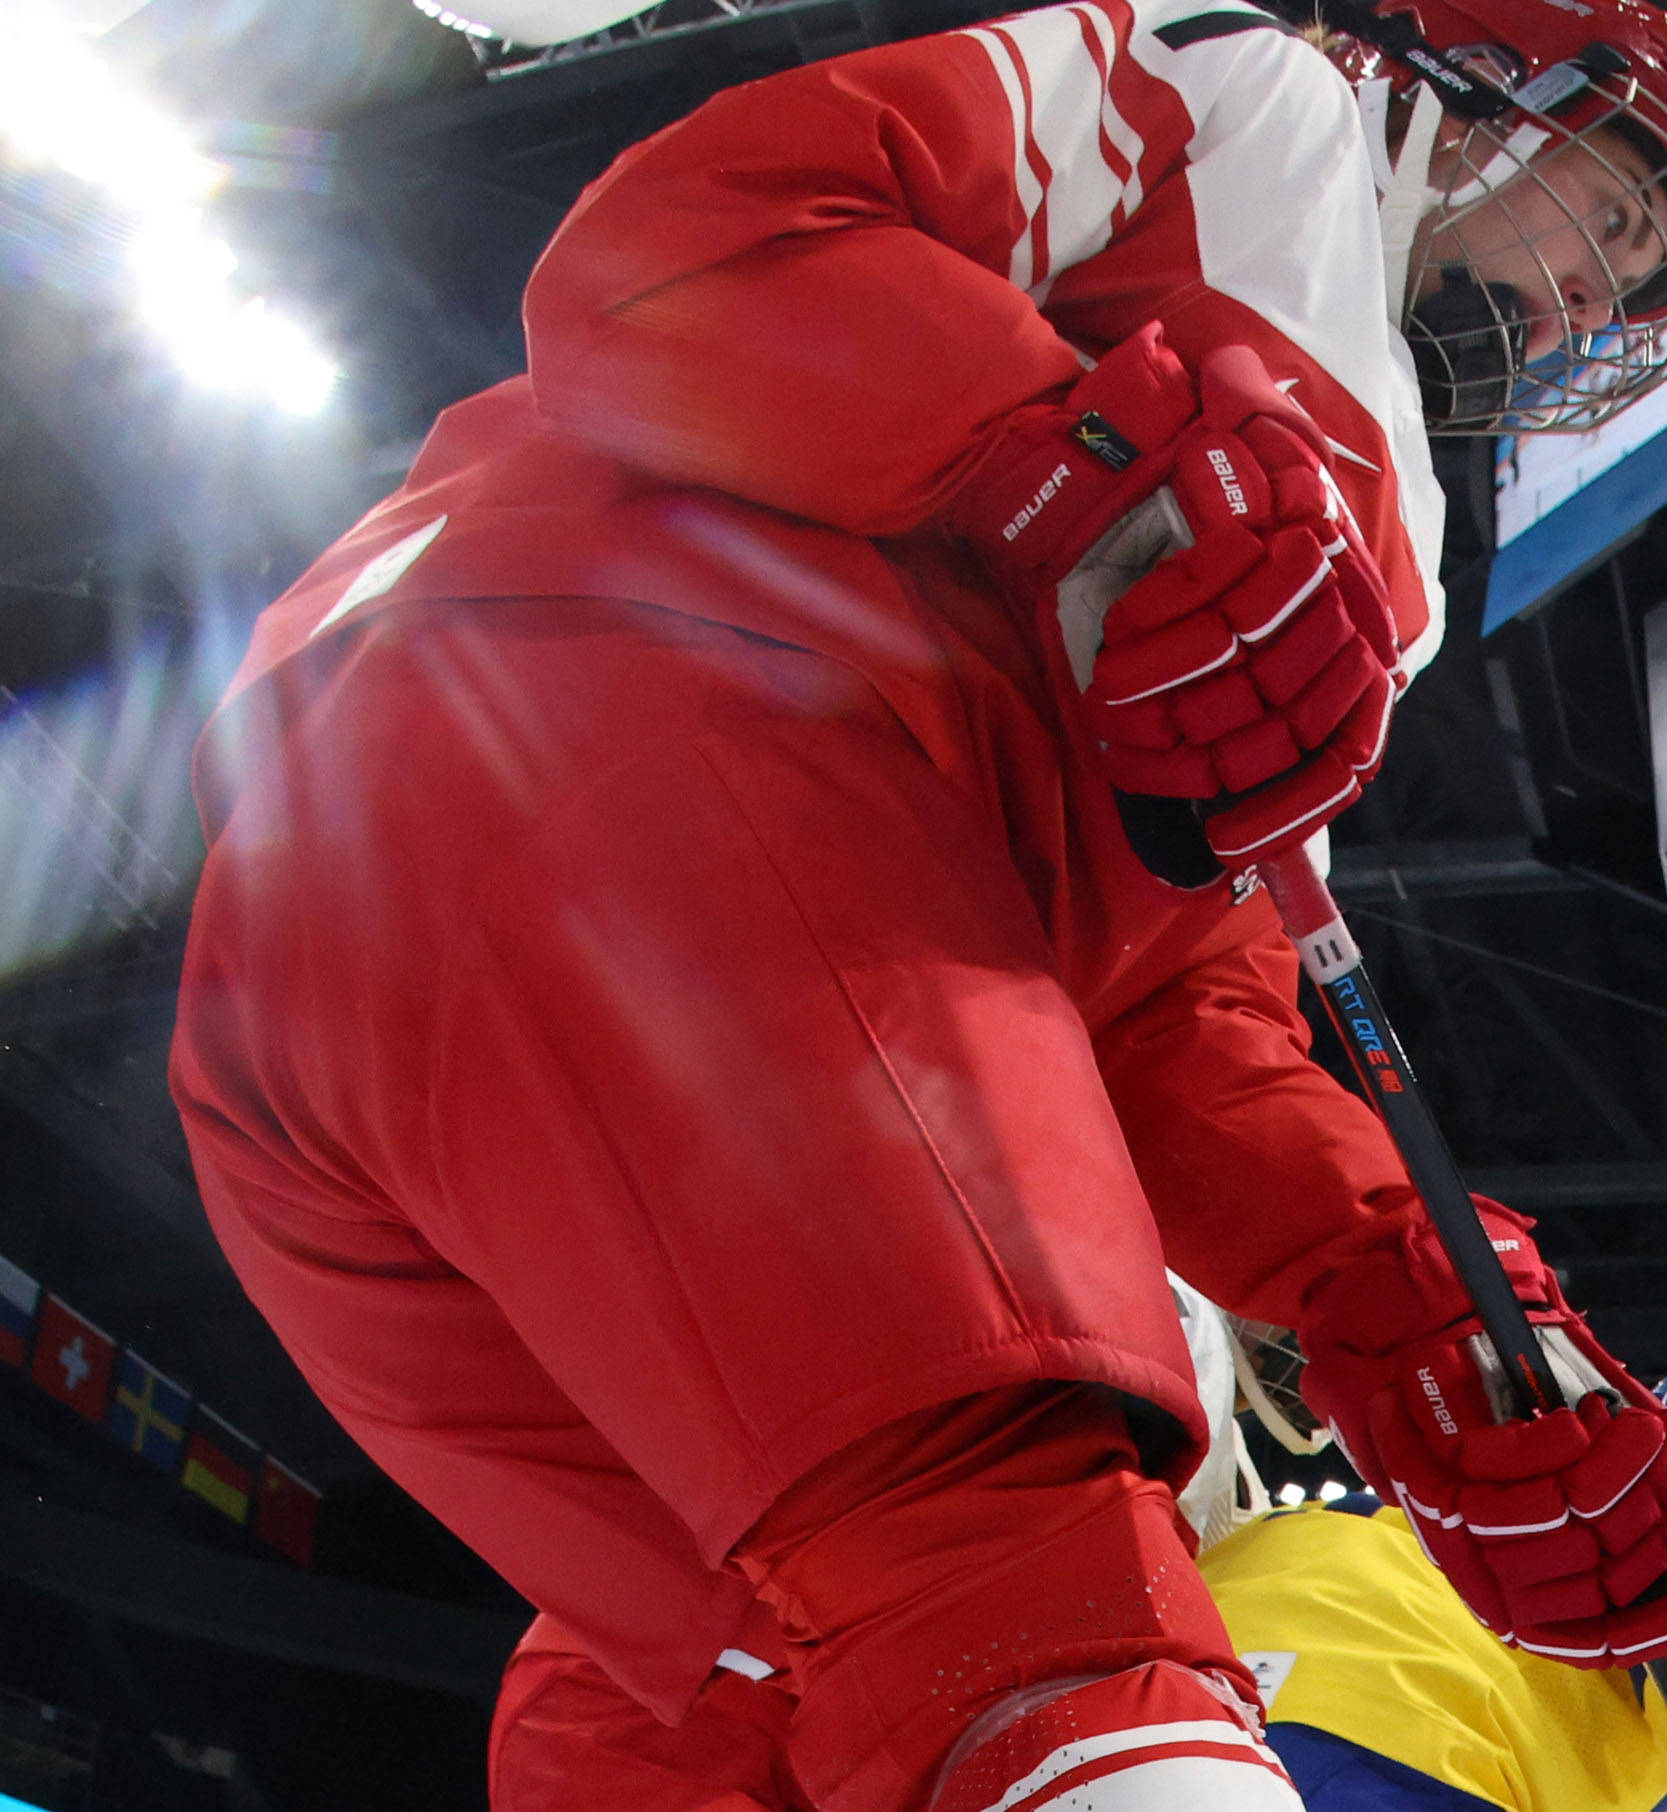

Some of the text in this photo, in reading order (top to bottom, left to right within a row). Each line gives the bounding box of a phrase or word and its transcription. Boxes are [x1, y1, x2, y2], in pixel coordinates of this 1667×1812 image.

[1406, 49, 1473, 93] BAUER
[1003, 463, 1072, 542] BAUER
[1206, 449, 1248, 516] BAUER
[1417, 1366, 1458, 1436] BAUER
